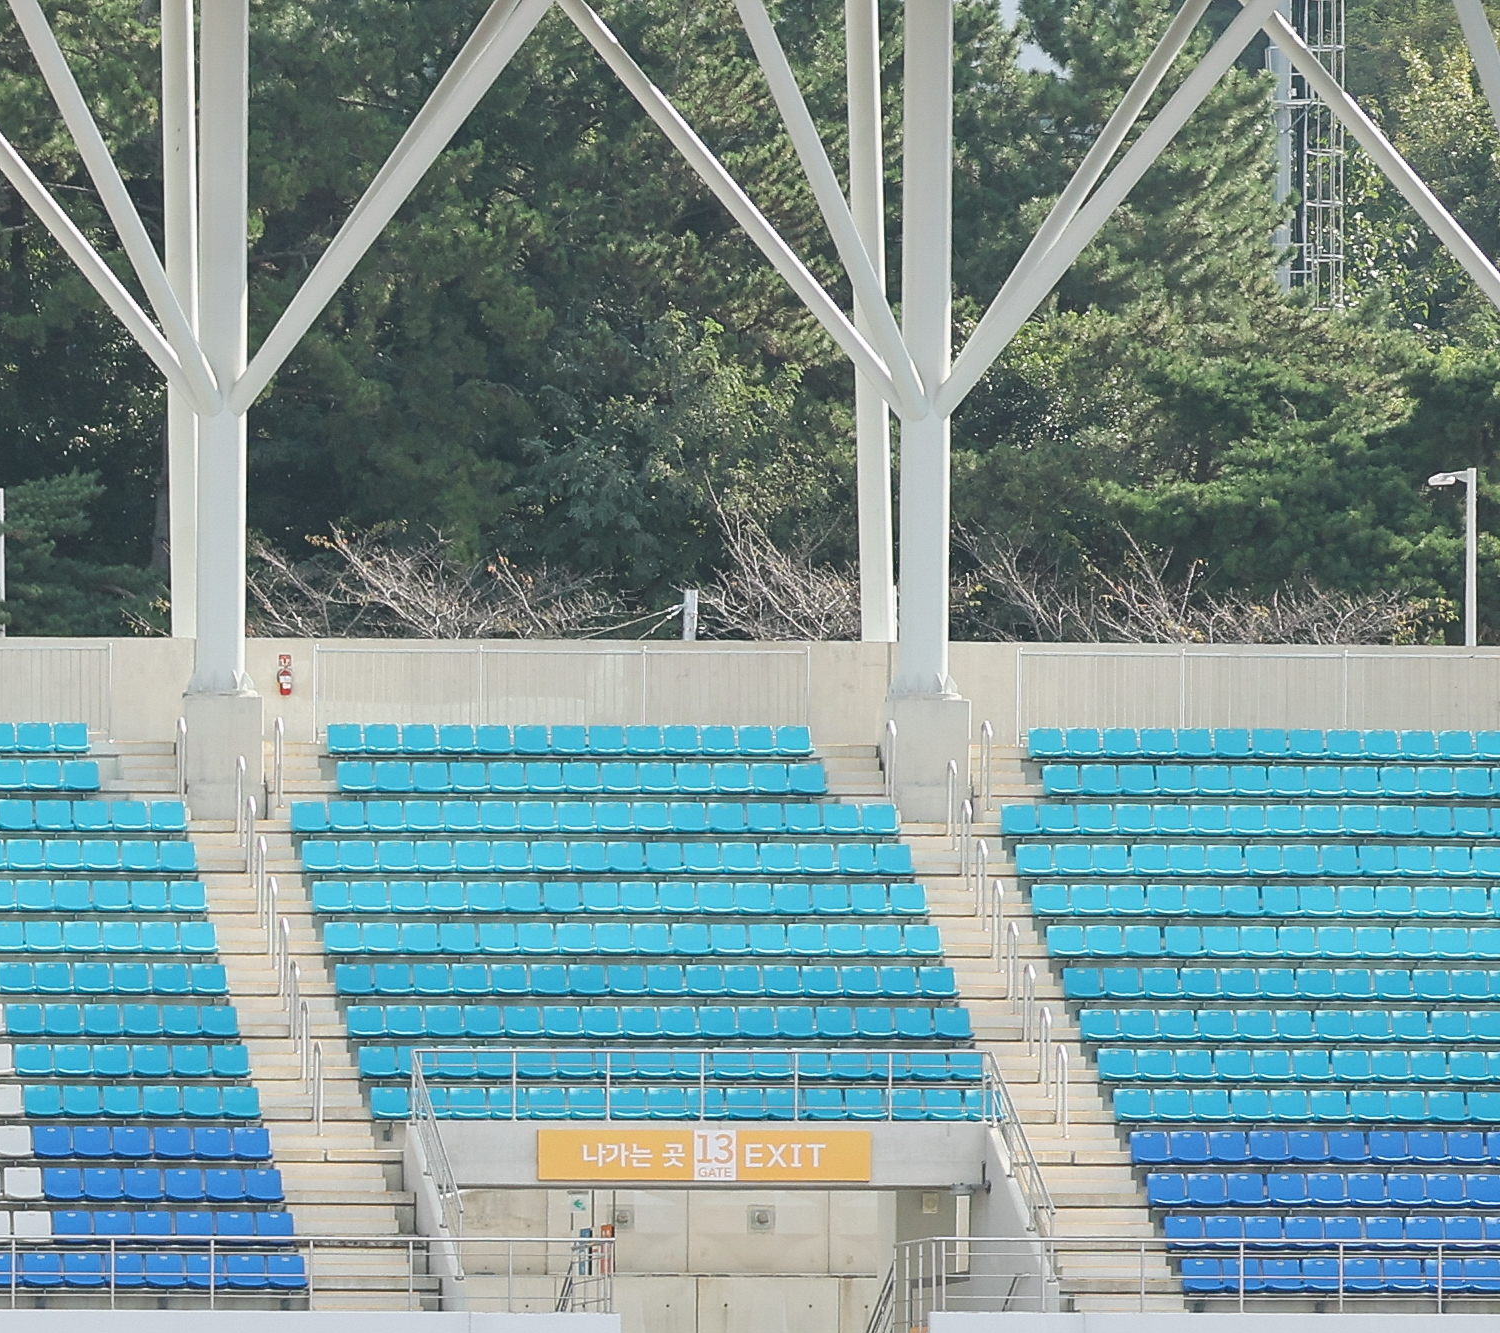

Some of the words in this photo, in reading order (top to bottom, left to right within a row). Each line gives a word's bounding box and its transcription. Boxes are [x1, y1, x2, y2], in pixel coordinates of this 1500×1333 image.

[582, 1143, 653, 1168] 나가는
[662, 1143, 686, 1169] 곳
[697, 1133, 735, 1165] 13
[745, 1143, 827, 1168] EXIT
[698, 1167, 733, 1178] GATE
